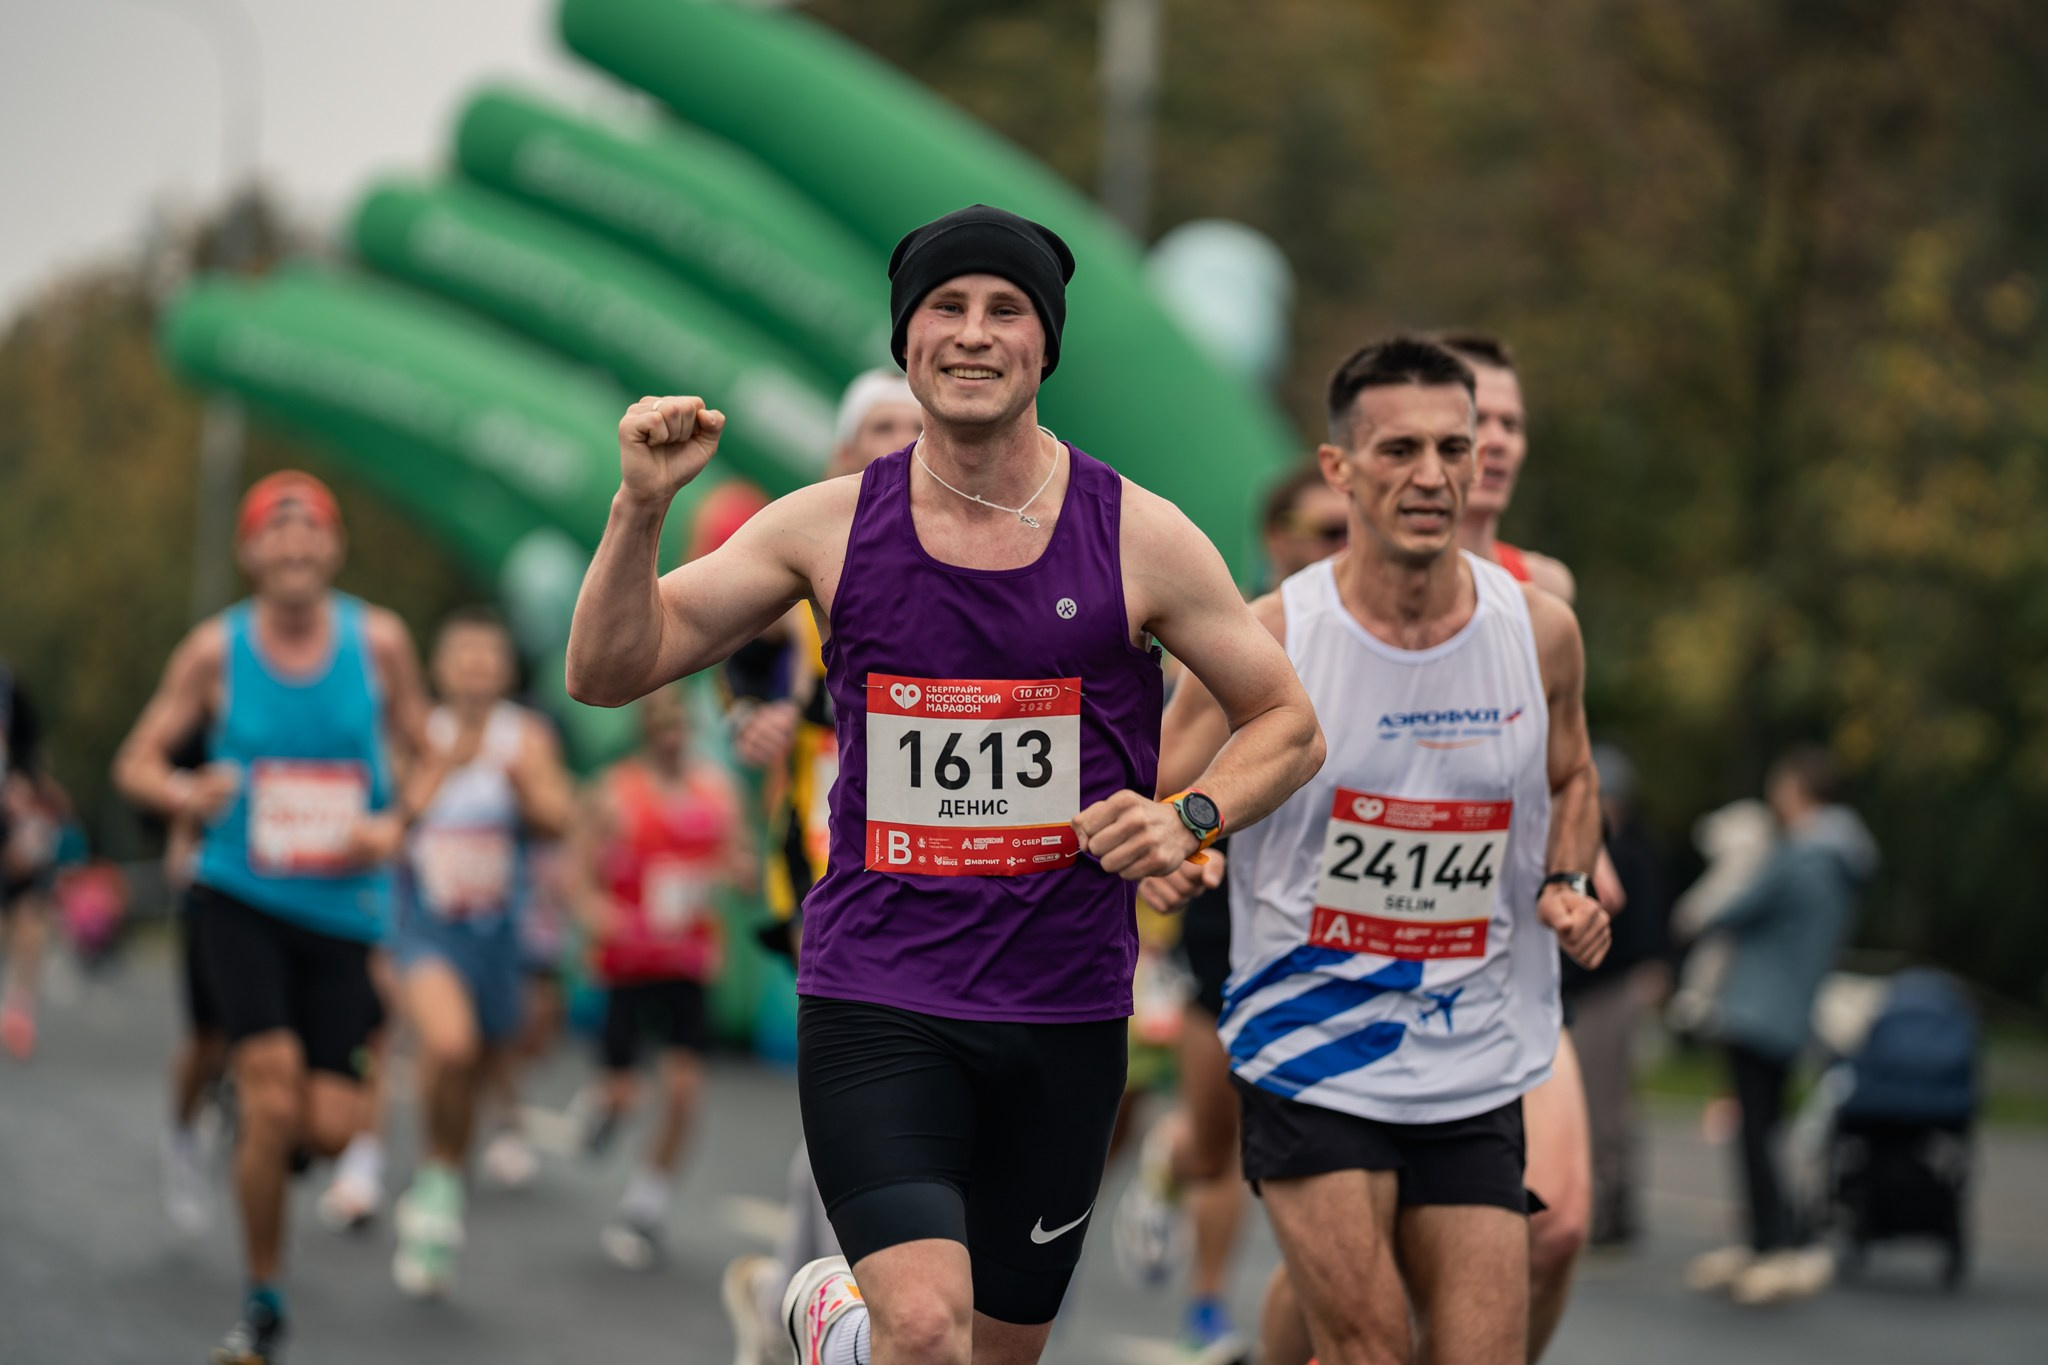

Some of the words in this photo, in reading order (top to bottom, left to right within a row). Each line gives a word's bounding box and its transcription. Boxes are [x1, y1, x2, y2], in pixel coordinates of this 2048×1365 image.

[926, 684, 982, 694] СБЕРПРАЙМ
[1019, 689, 1033, 698] 10
[926, 693, 1001, 704] МОСКОВСКИЙ
[926, 703, 982, 713] МАРАФОН
[899, 730, 1053, 790] 1613
[938, 799, 1009, 818] ДЕНИС
[1021, 838, 1041, 846] СБЕР
[1328, 833, 1493, 891] 24144
[1384, 893, 1437, 912] SELIM
[1322, 914, 1351, 946] A
